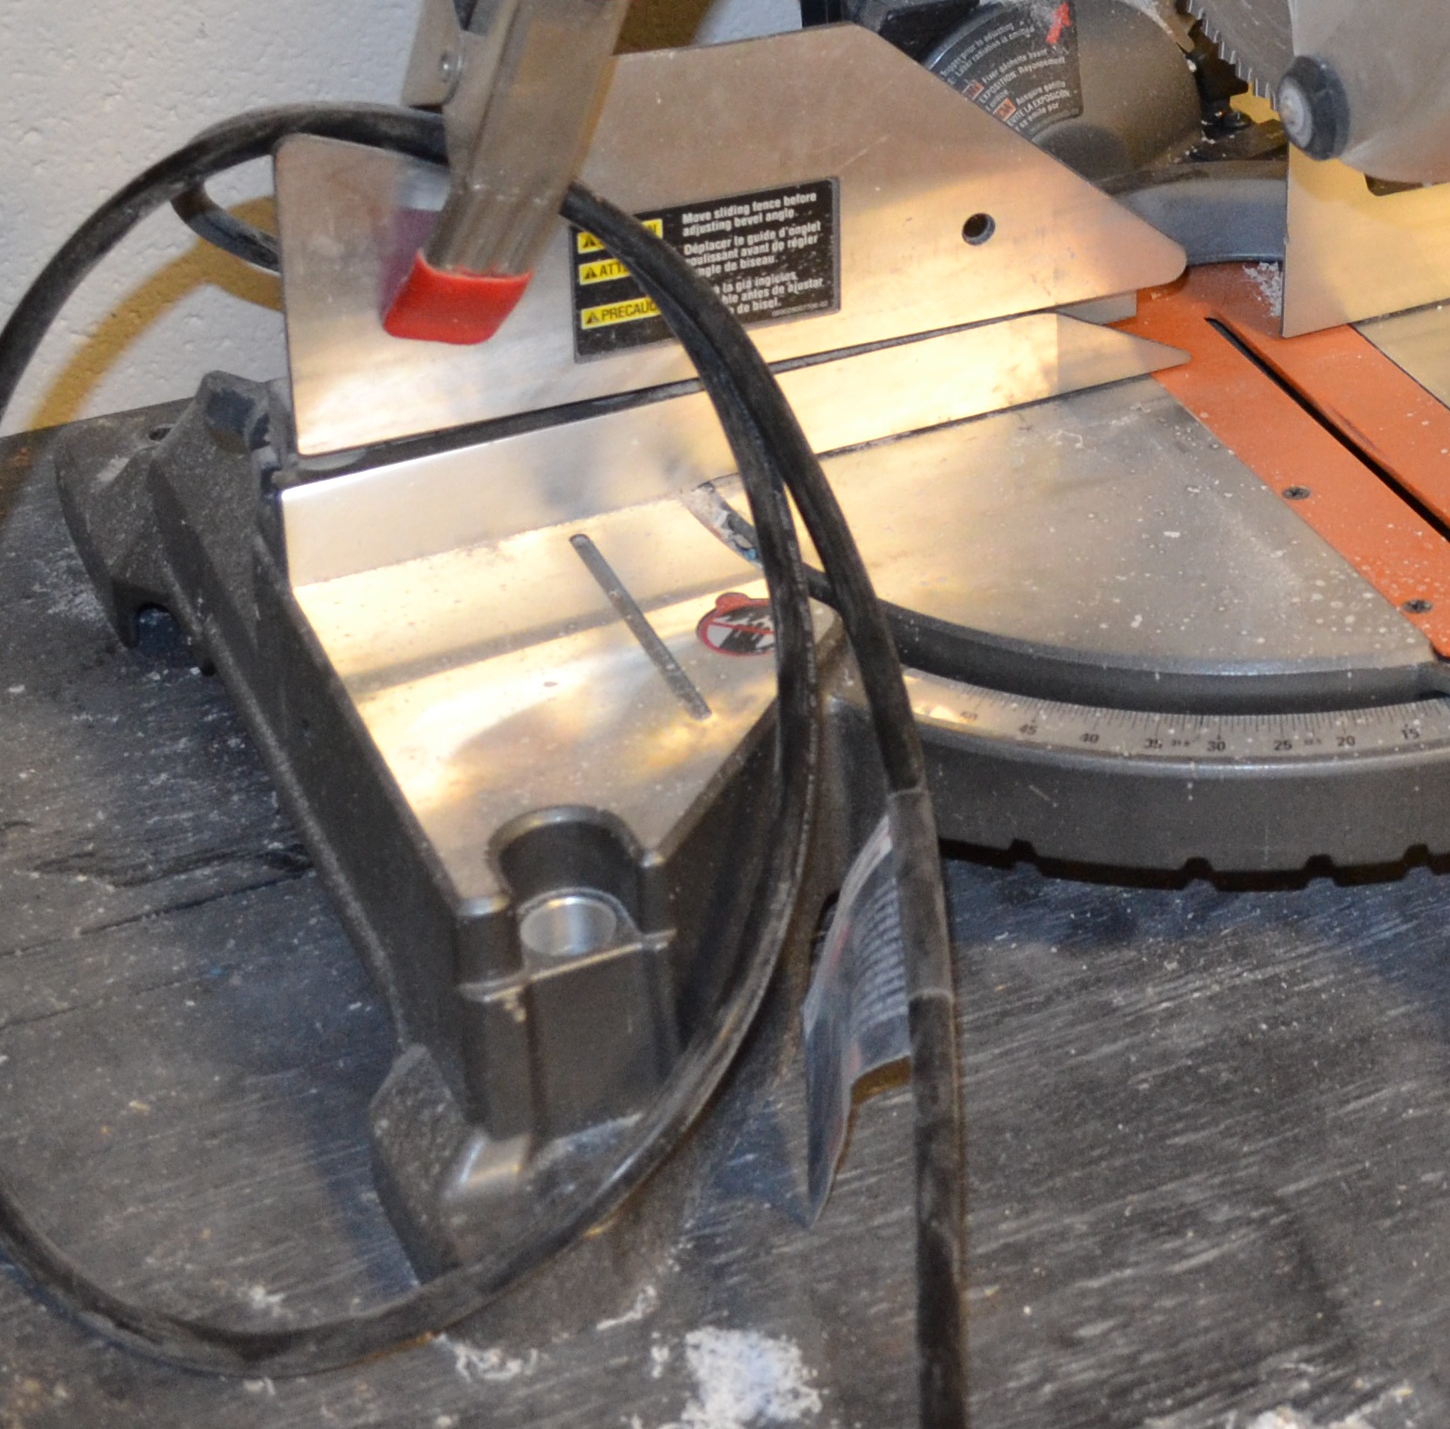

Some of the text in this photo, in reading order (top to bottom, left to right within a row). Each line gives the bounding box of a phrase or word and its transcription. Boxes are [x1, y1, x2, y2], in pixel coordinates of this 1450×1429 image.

[682, 192, 817, 225] Move sliding fence before
[682, 219, 732, 237] adjusting
[734, 212, 763, 228] bevel
[734, 235, 745, 246] le
[747, 230, 776, 246] guide
[740, 242, 770, 257] avant
[772, 240, 784, 252] de
[724, 261, 738, 272] de
[722, 282, 733, 293] la
[741, 288, 769, 301] antes
[772, 285, 785, 295] de
[787, 278, 823, 294] ajustar
[737, 303, 750, 314] de
[1079, 732, 1099, 744] 40
[1206, 740, 1226, 752] 30
[1274, 740, 1292, 751] 25
[1336, 734, 1356, 748] 20
[1402, 727, 1420, 740] 15
